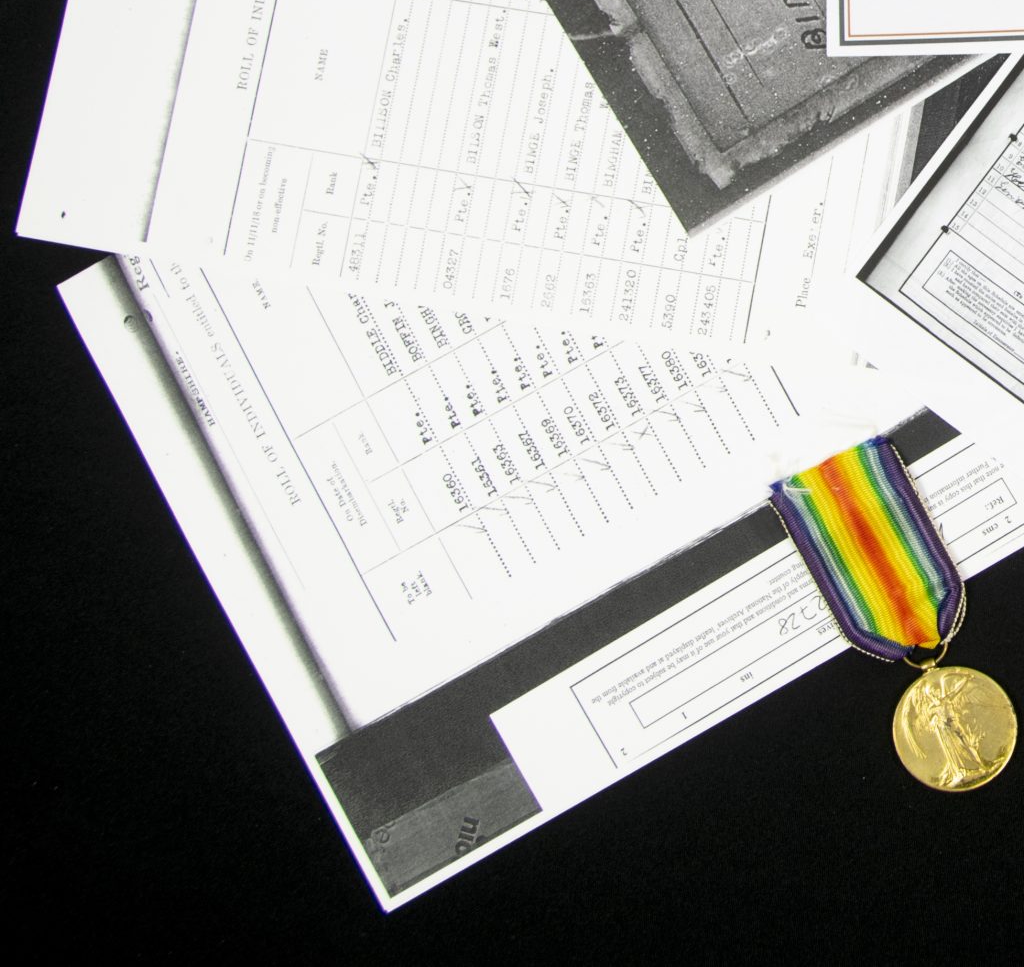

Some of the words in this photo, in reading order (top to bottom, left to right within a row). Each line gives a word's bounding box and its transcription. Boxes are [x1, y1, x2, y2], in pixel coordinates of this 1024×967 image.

[236, 53, 255, 90] ROLL
[246, 27, 259, 46] OF
[314, 48, 329, 81] NAME
[573, 81, 594, 132] Thomas
[325, 171, 338, 196] Rank
[178, 276, 190, 290] to
[442, 248, 459, 290] 04327
[618, 269, 637, 322] 241320
[697, 285, 717, 336] 243405
[794, 277, 811, 308] Place
[185, 293, 215, 338] entitled
[365, 327, 398, 377] BIDDLE
[391, 316, 423, 363] BOFFIN
[534, 344, 554, 379] Pte.
[661, 350, 689, 391] 16380
[210, 342, 267, 440] INDIVIDUALS
[613, 375, 642, 417] 16373
[637, 361, 666, 404] 16377
[443, 396, 462, 429] Pte.
[563, 405, 590, 445] 16370
[588, 391, 616, 431] 16372
[261, 445, 278, 463] OF
[492, 443, 520, 485] 16363
[276, 466, 301, 506] ROLL
[442, 473, 469, 513] 16360
[981, 522, 999, 536] cms
[410, 580, 423, 597] left
[744, 592, 773, 612] National
[754, 594, 787, 617] conditions
[715, 627, 730, 640] your
[729, 620, 744, 633] that
[643, 666, 667, 685] subject
[739, 671, 754, 683] ins
[606, 685, 637, 707] copyright
